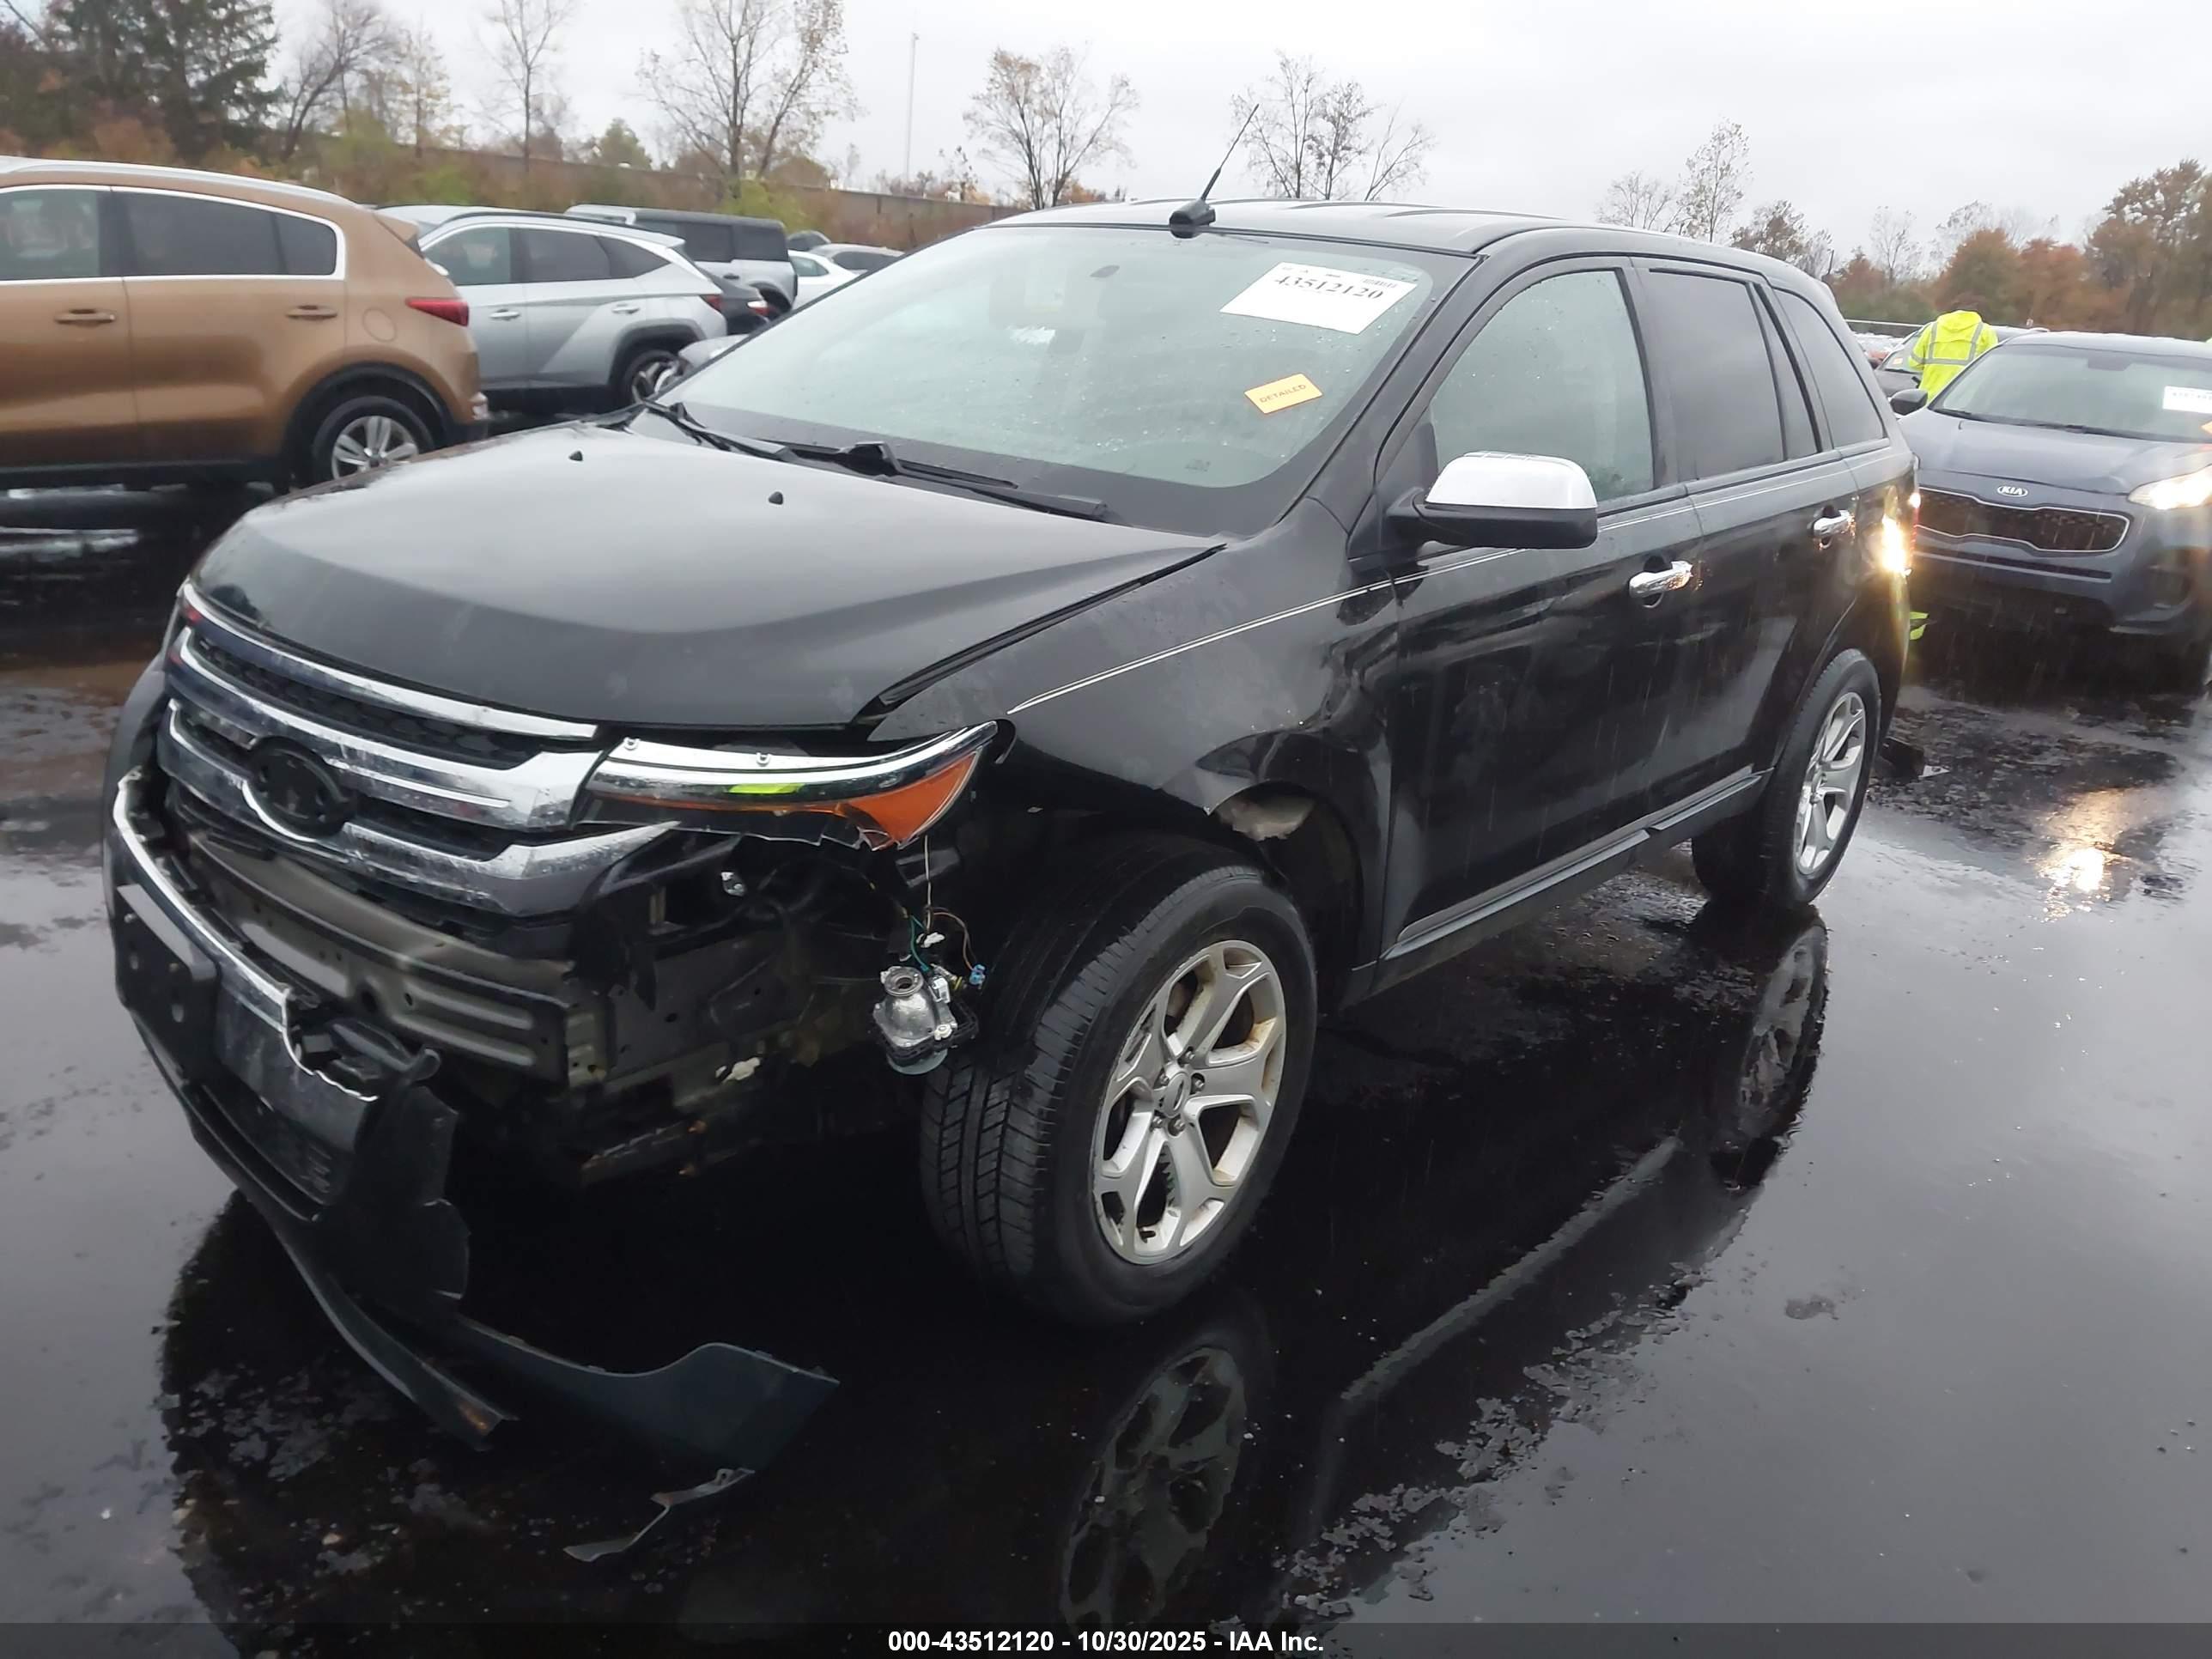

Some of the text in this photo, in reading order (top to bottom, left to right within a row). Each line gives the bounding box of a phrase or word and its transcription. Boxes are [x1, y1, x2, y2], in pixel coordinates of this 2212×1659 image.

[1274, 275, 1383, 300] 43512120
[1259, 384, 1306, 403] DETAILED
[2000, 485, 2025, 496] KIA
